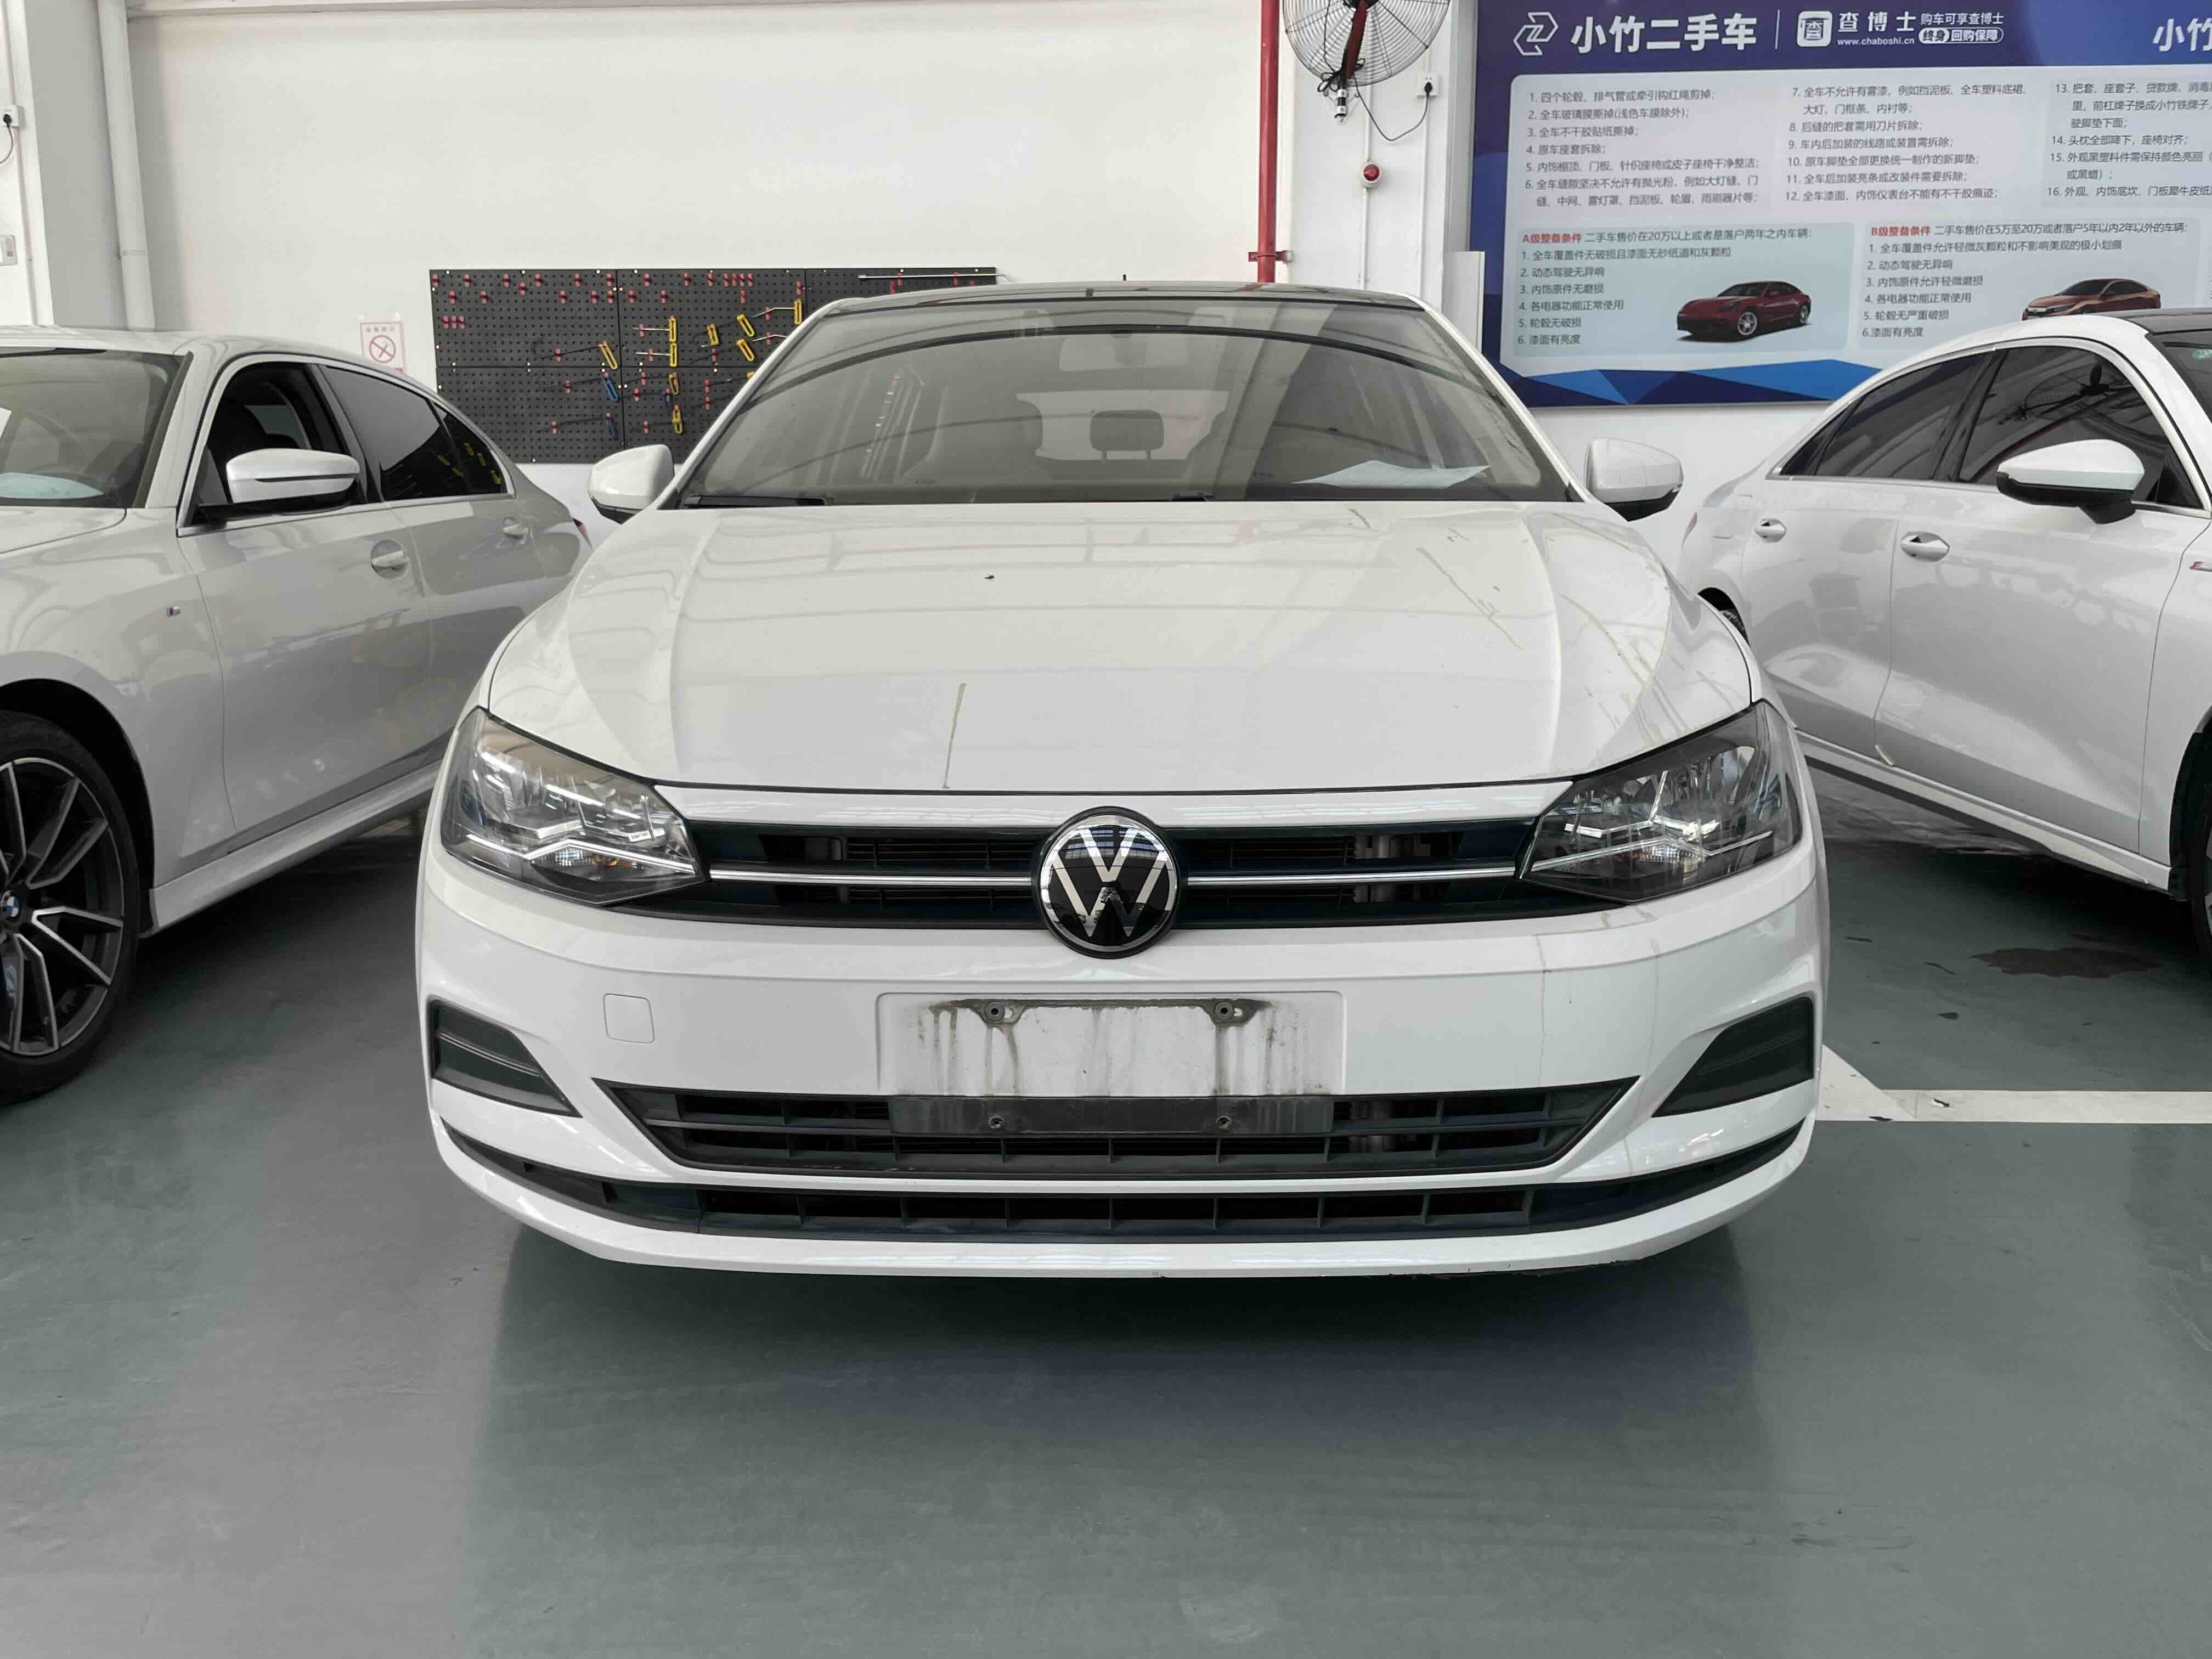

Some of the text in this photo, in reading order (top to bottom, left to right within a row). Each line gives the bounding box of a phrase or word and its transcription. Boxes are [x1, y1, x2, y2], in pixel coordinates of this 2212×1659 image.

[1838, 12, 1916, 32] 查博士
[1921, 12, 2004, 25] 购车可享查博士
[1571, 13, 1757, 53] 小竹二手车
[2153, 18, 2212, 52] 小竹
[1837, 37, 1915, 46] www.chaboshi.cn
[1532, 267, 1605, 278] 动态驾驶无异响
[1877, 293, 1971, 304] 各电器功能正常使用
[1531, 300, 1624, 312] 各电器功能正常使用
[1875, 309, 1949, 321] 轮毂无严重破损
[1530, 317, 1582, 329] 轮毂无破损
[1530, 334, 1581, 345] 漆面有亮度
